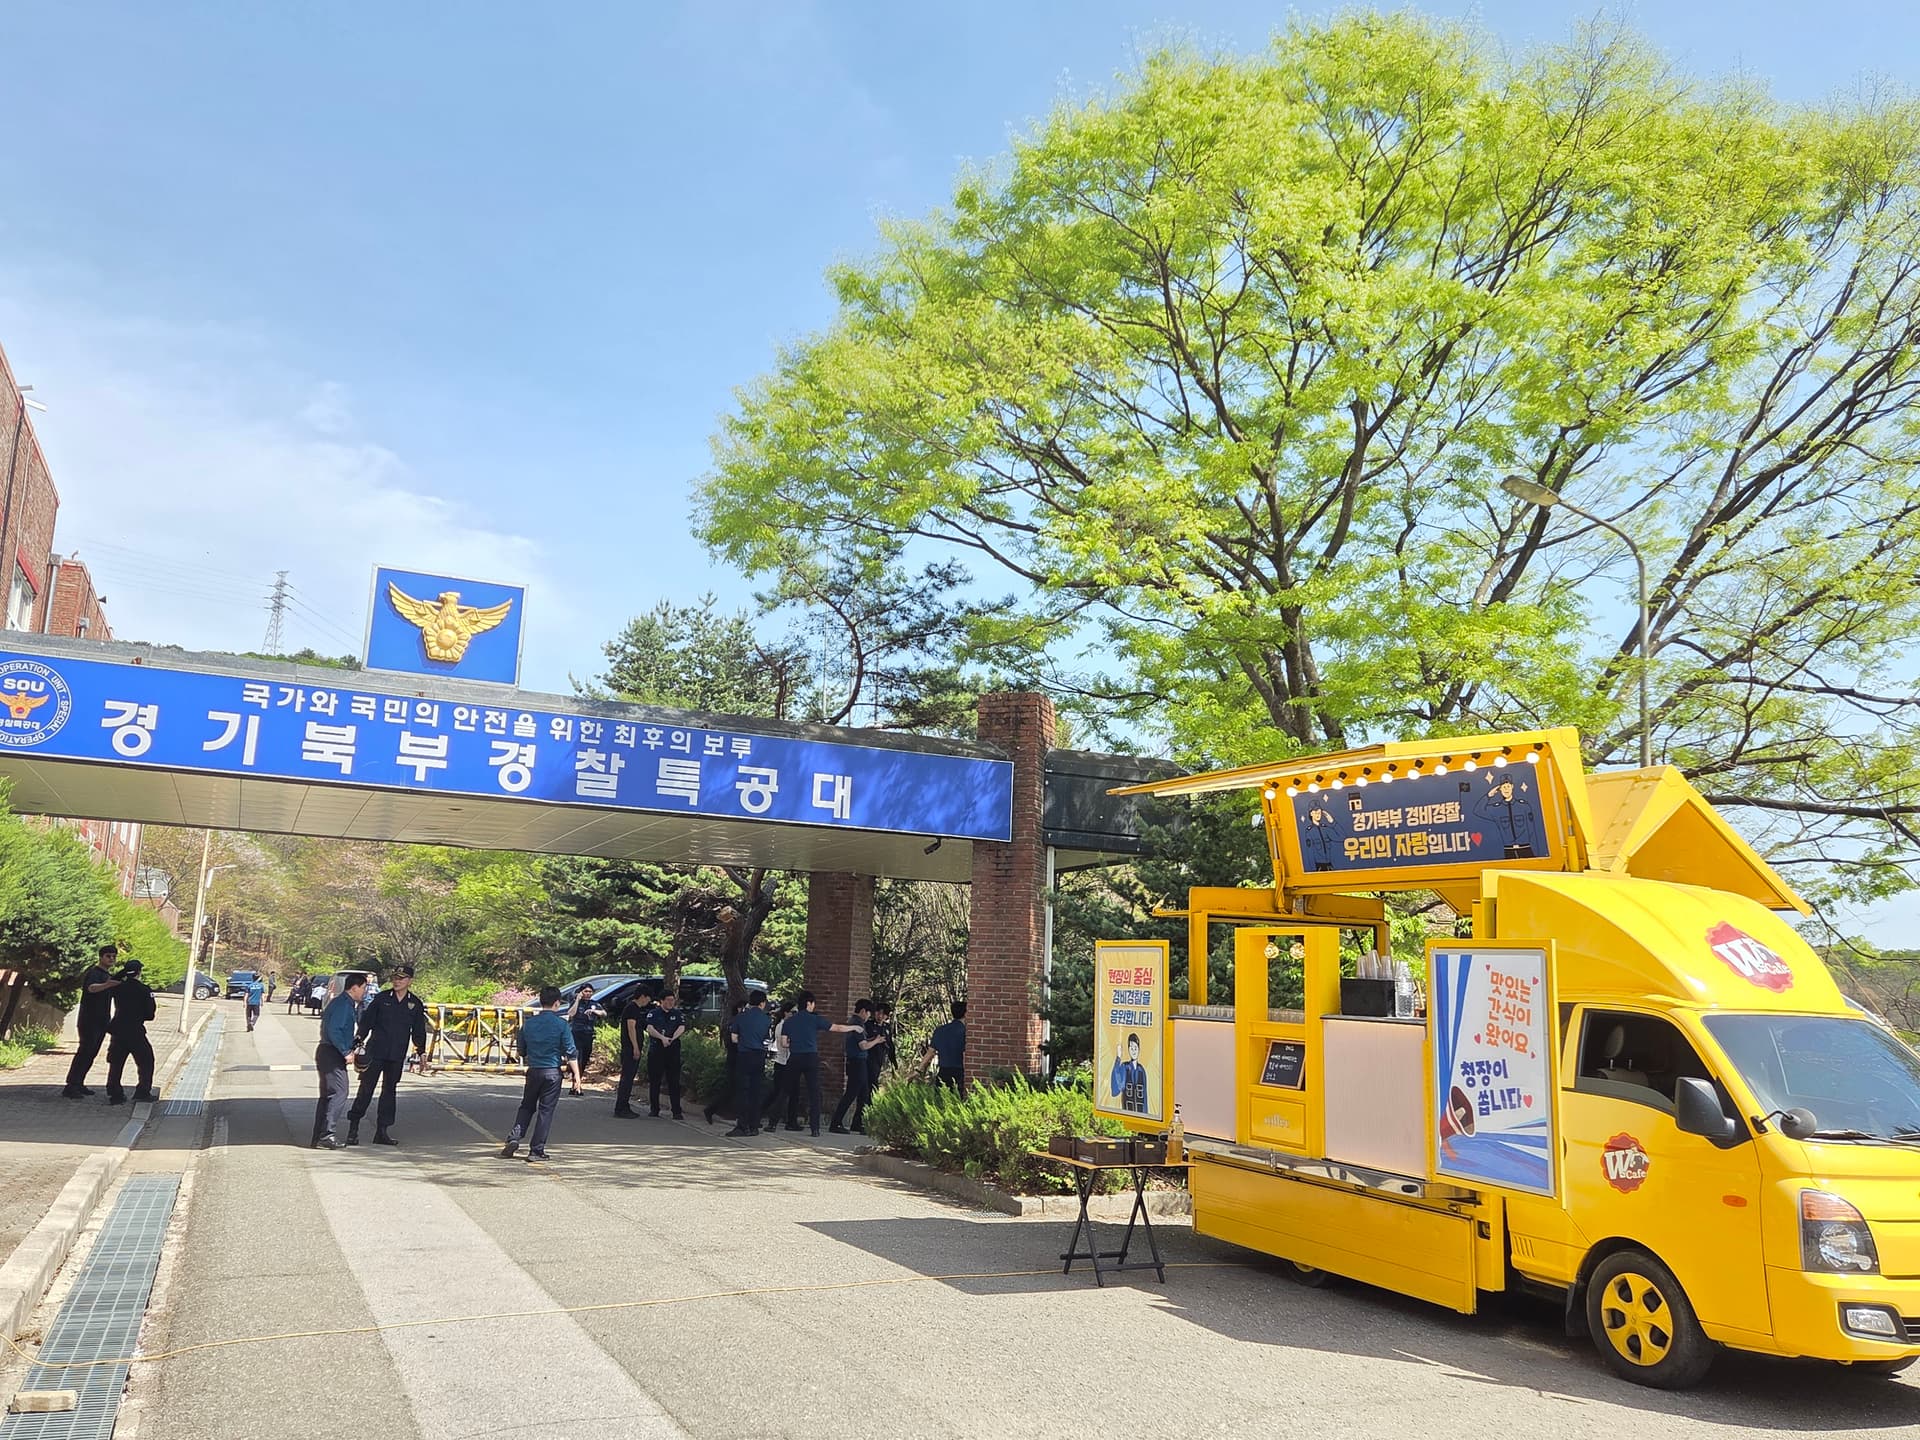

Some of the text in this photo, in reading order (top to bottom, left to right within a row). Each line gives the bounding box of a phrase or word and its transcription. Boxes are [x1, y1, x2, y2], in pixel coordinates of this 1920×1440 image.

[3, 678, 45, 693] SOU
[51, 675, 67, 694] UNIT
[47, 700, 70, 732] SPECIAL
[243, 683, 753, 760] 국가와 국민의 안전을 위한 최후의 보루
[1352, 801, 1465, 832] 경기북부 경비경찰,
[1343, 831, 1471, 861] 우리의 자랑입니다
[1108, 967, 1155, 986] 현장의 중심,
[1490, 971, 1531, 1004] 맛있는
[1112, 989, 1151, 1006] 경비경찰을
[1487, 996, 1531, 1026] 간식이
[1110, 1009, 1153, 1027] 응원합니다!
[1485, 1023, 1529, 1054] 왔어요
[1460, 1058, 1508, 1088] 청장이
[1477, 1087, 1522, 1117] 쏩니다
